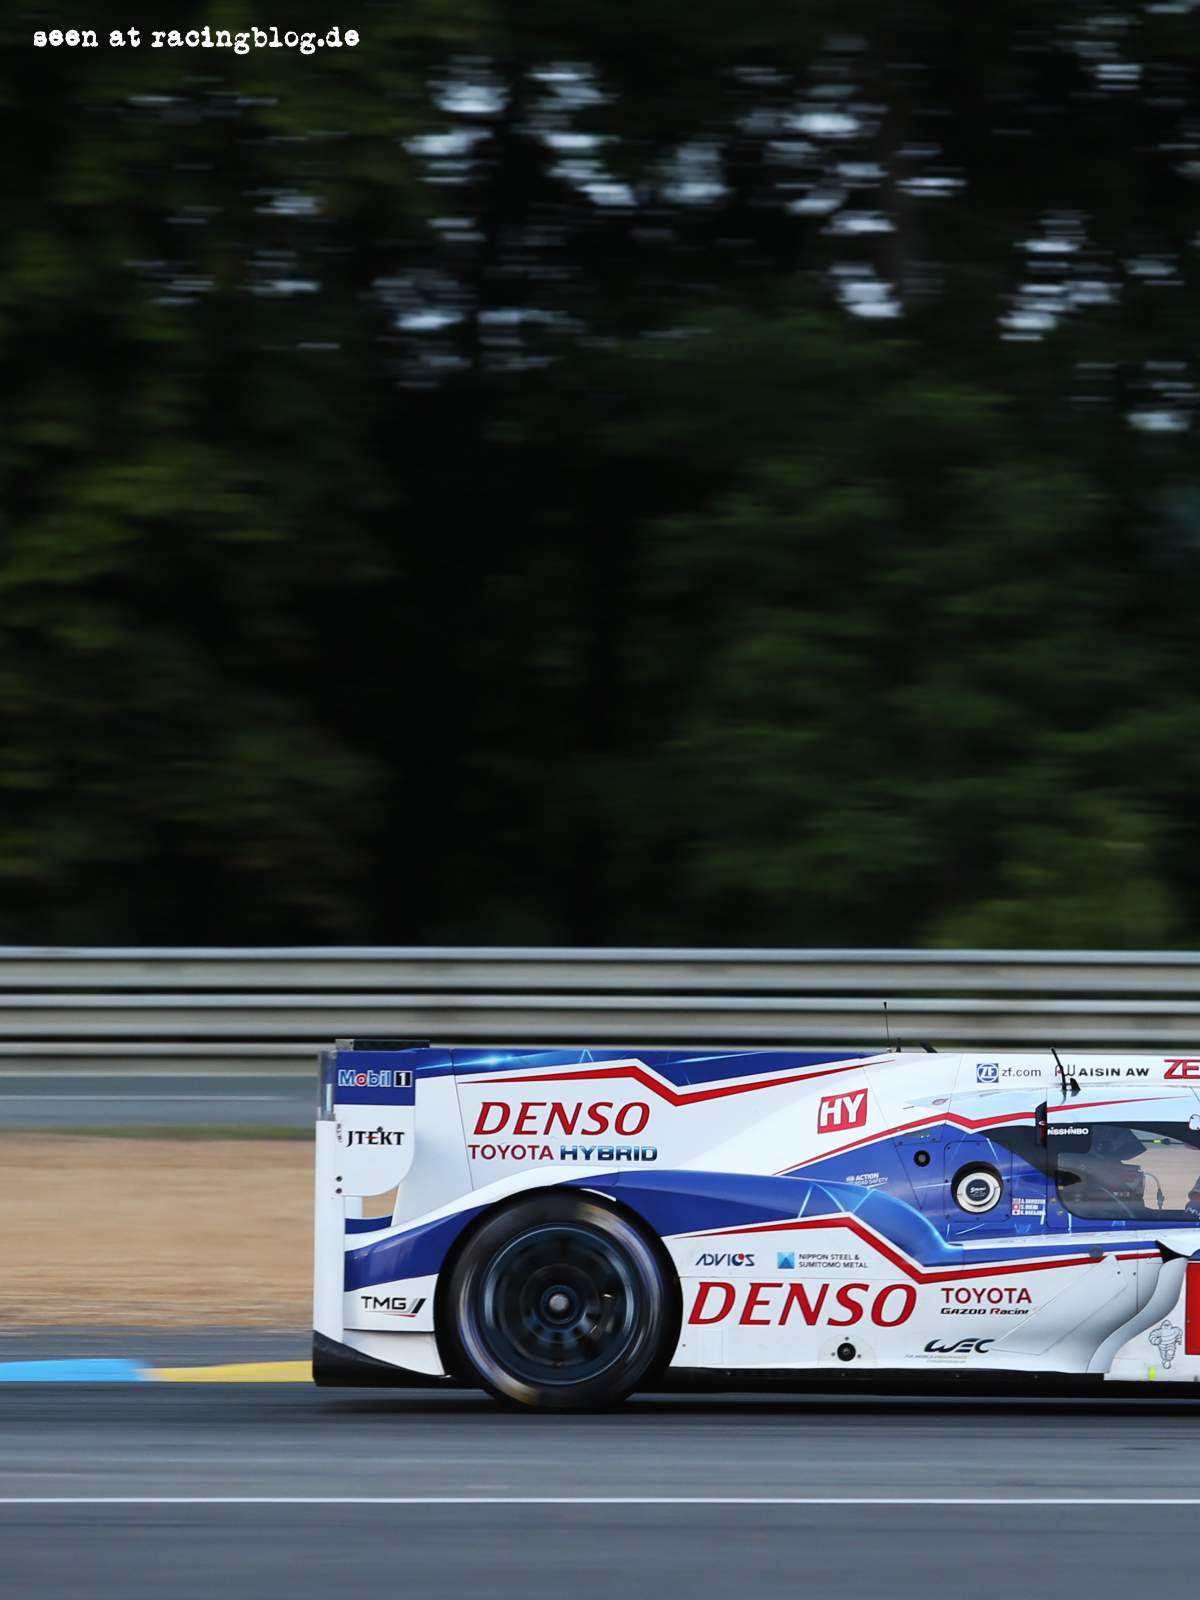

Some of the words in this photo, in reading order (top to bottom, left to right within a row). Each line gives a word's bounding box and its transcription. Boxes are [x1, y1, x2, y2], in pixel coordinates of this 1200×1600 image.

[338, 1069, 392, 1087] Mobil
[1001, 1067, 1042, 1077] zf.com
[1079, 1067, 1121, 1077] AISIN
[1126, 1067, 1150, 1077] AW
[819, 1092, 866, 1127] HY
[473, 1101, 651, 1136] DENSO
[346, 1126, 405, 1147] JTEKT
[467, 1145, 554, 1160] TOYOTA
[560, 1145, 658, 1162] HYBRID
[361, 1296, 407, 1310] TMG
[940, 1287, 1033, 1304] TOYOTA
[687, 1281, 918, 1328] DENSO
[924, 1338, 995, 1354] WEC
